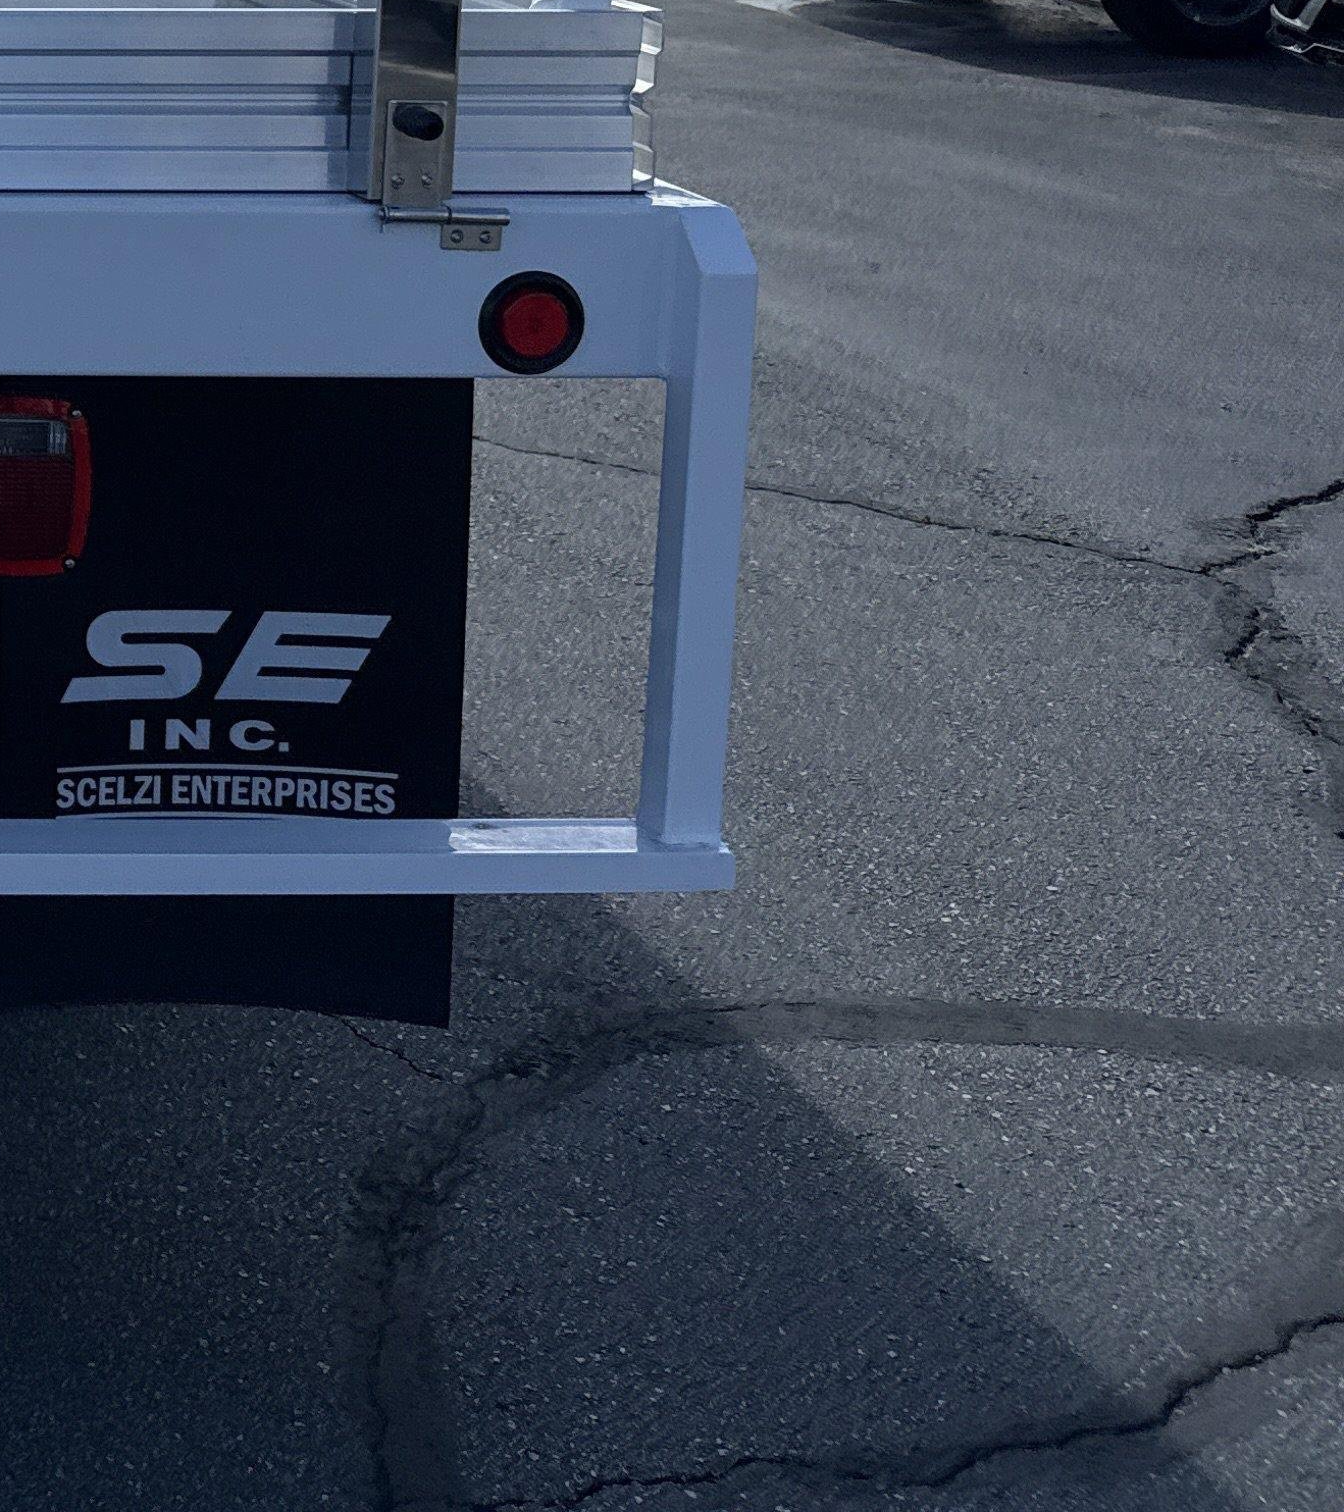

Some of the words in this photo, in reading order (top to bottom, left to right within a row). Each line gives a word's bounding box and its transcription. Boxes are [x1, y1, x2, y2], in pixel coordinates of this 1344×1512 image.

[60, 609, 393, 704] SE
[129, 718, 290, 752] INC.
[56, 774, 161, 808] SCELZI
[172, 774, 396, 815] ENTERPRISES
